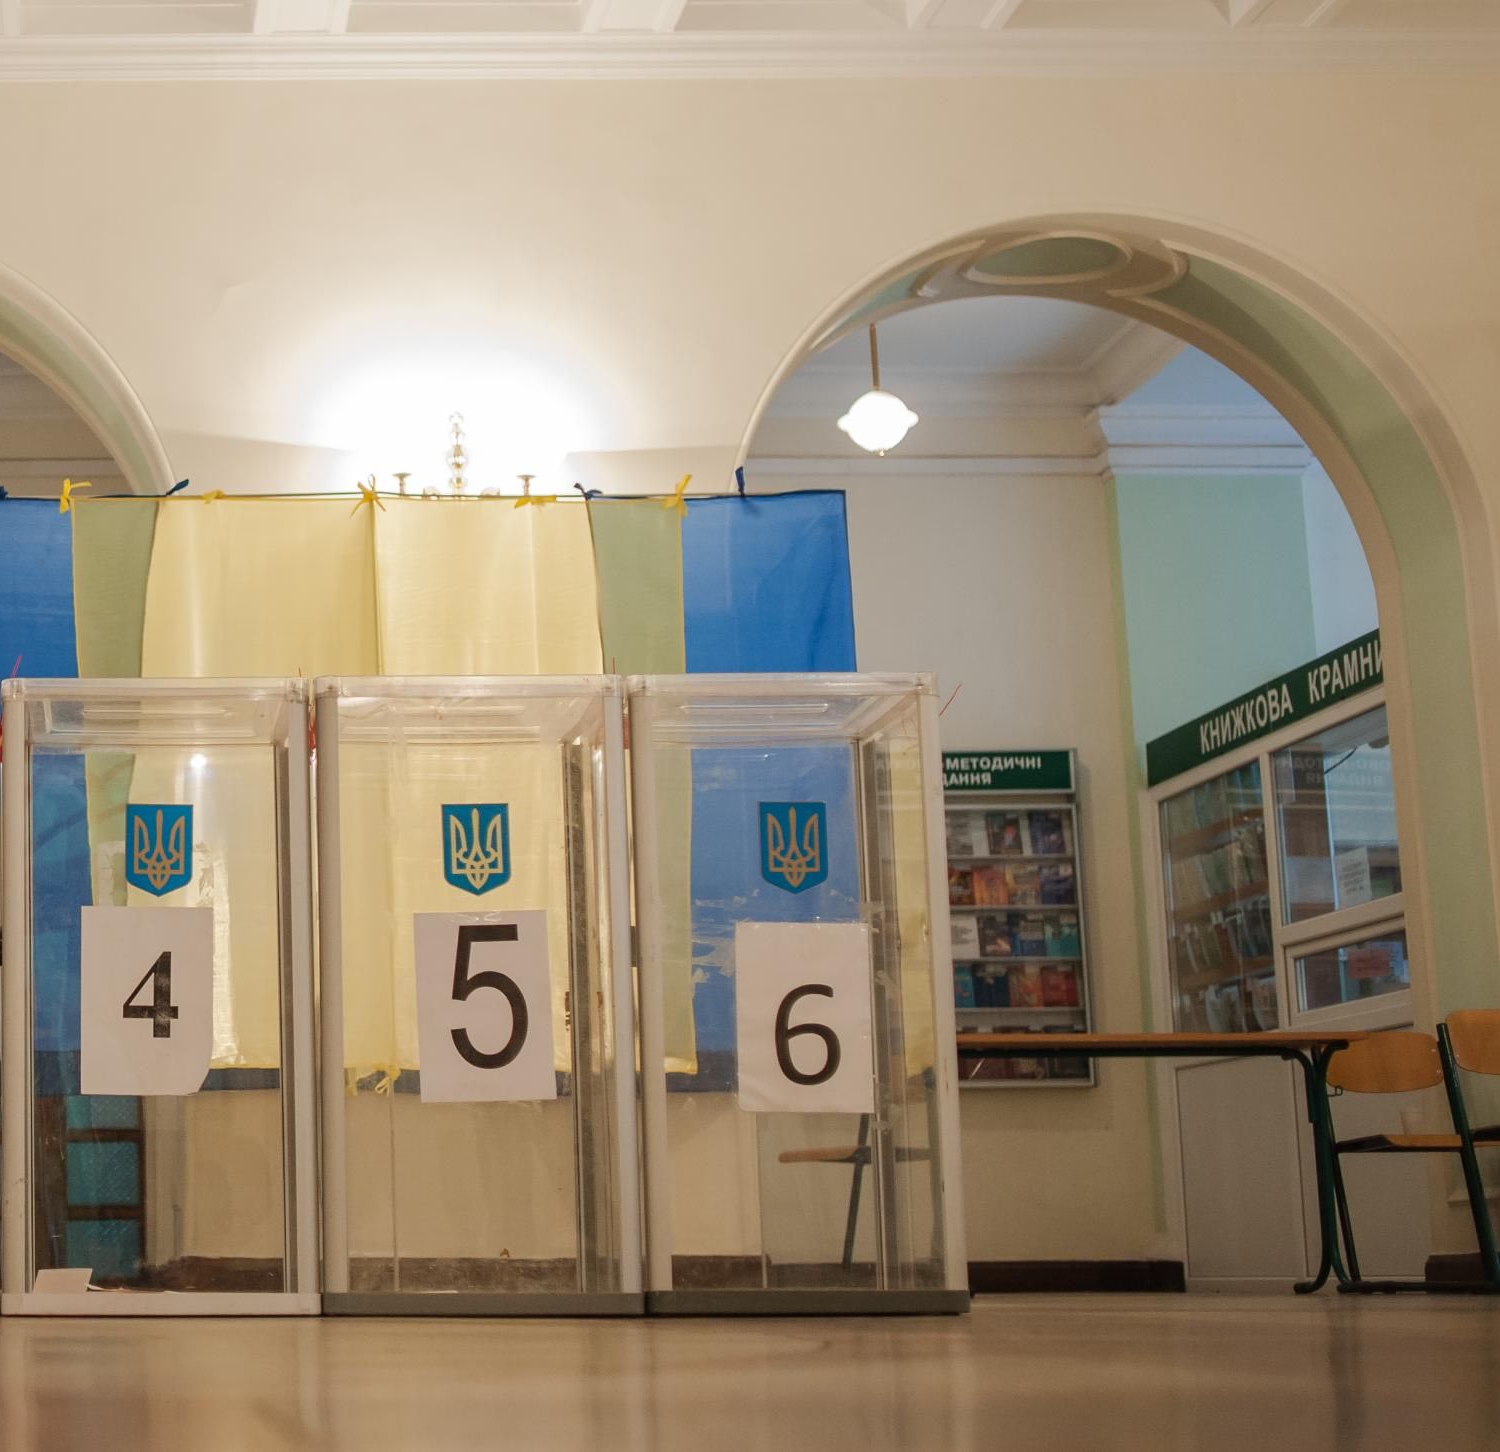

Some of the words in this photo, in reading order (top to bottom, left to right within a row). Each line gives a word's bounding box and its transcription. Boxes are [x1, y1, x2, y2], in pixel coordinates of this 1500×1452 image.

[1200, 684, 1293, 755] КНИЖКОВА
[122, 951, 179, 1039] 4
[450, 923, 528, 1069] 5
[774, 983, 841, 1086] 6
